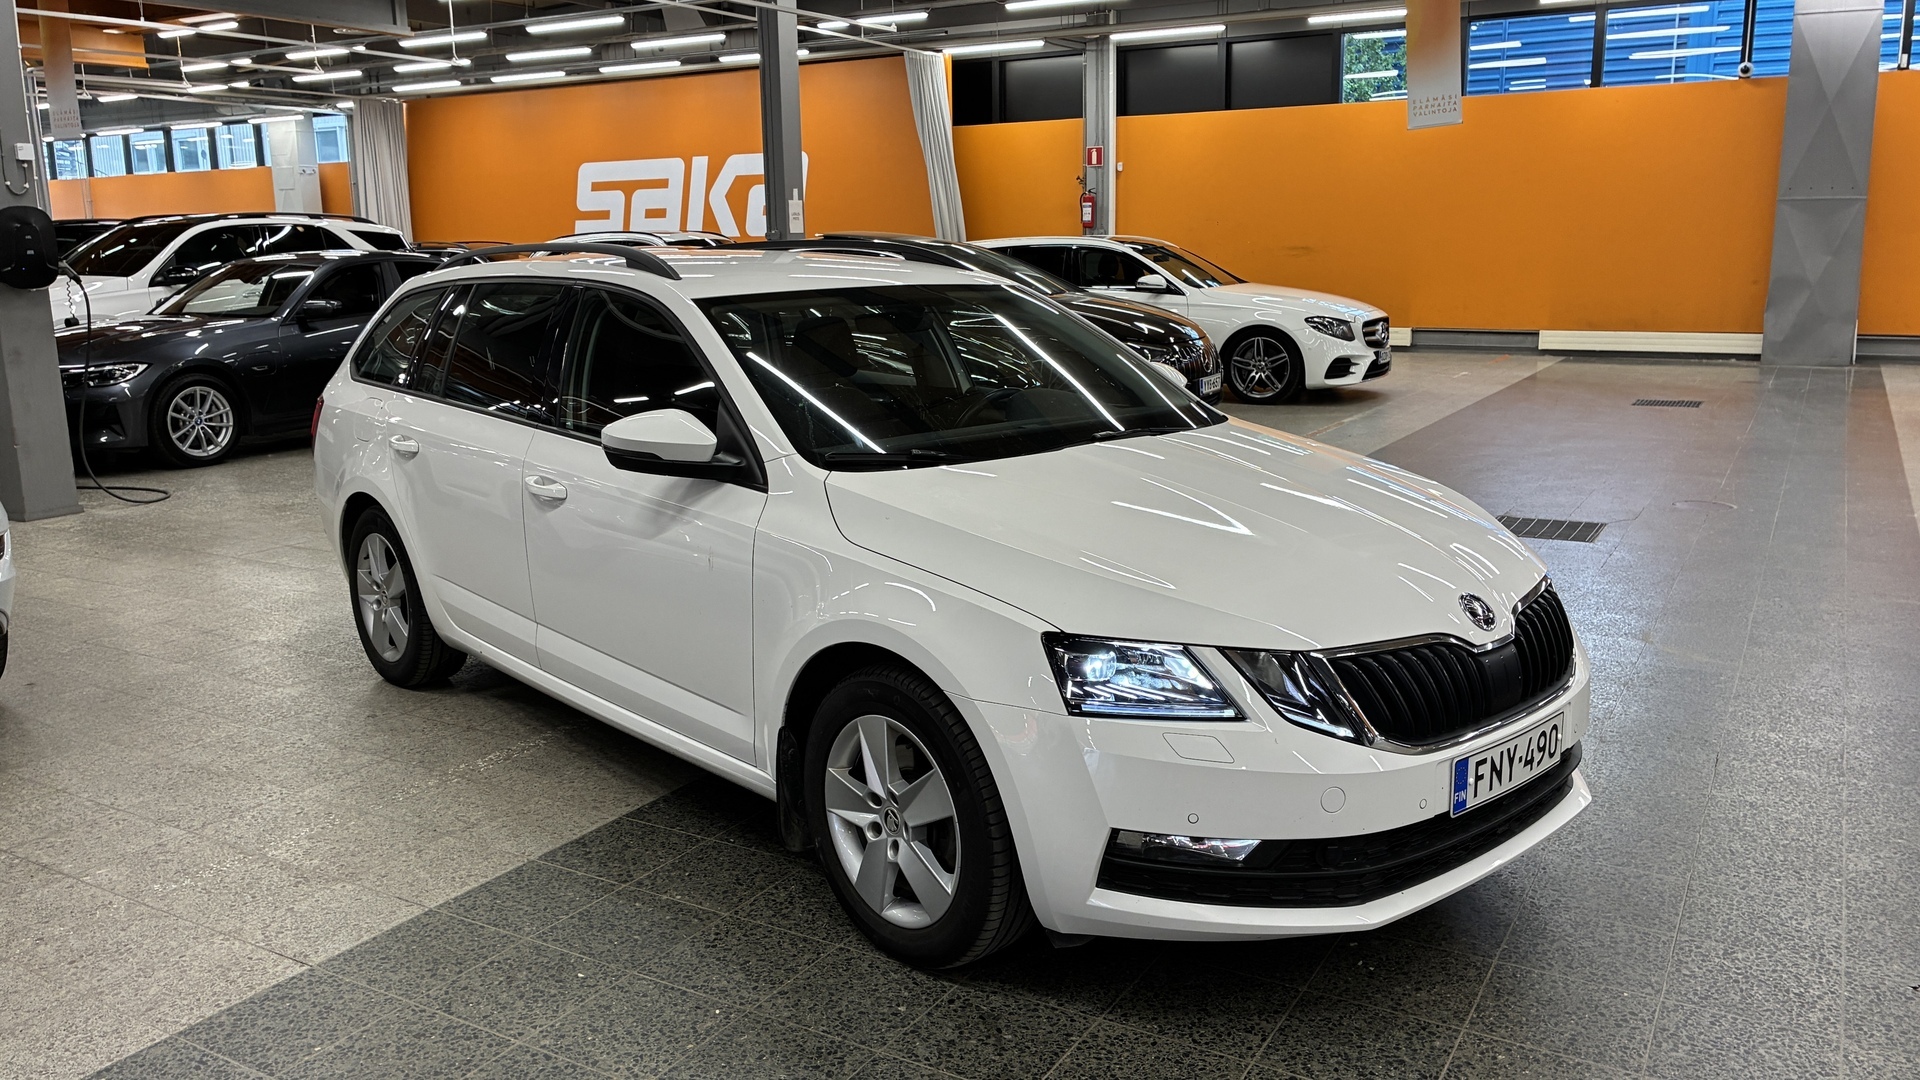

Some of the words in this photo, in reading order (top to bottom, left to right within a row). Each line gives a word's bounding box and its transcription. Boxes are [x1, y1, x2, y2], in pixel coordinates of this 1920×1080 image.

[1412, 93, 1457, 105] ELÄMÄSI
[1412, 101, 1458, 111] PARHAITA
[1412, 108, 1458, 117] VALINTOJA
[1473, 723, 1559, 798] FNY-490
[1454, 789, 1467, 804] FIN
